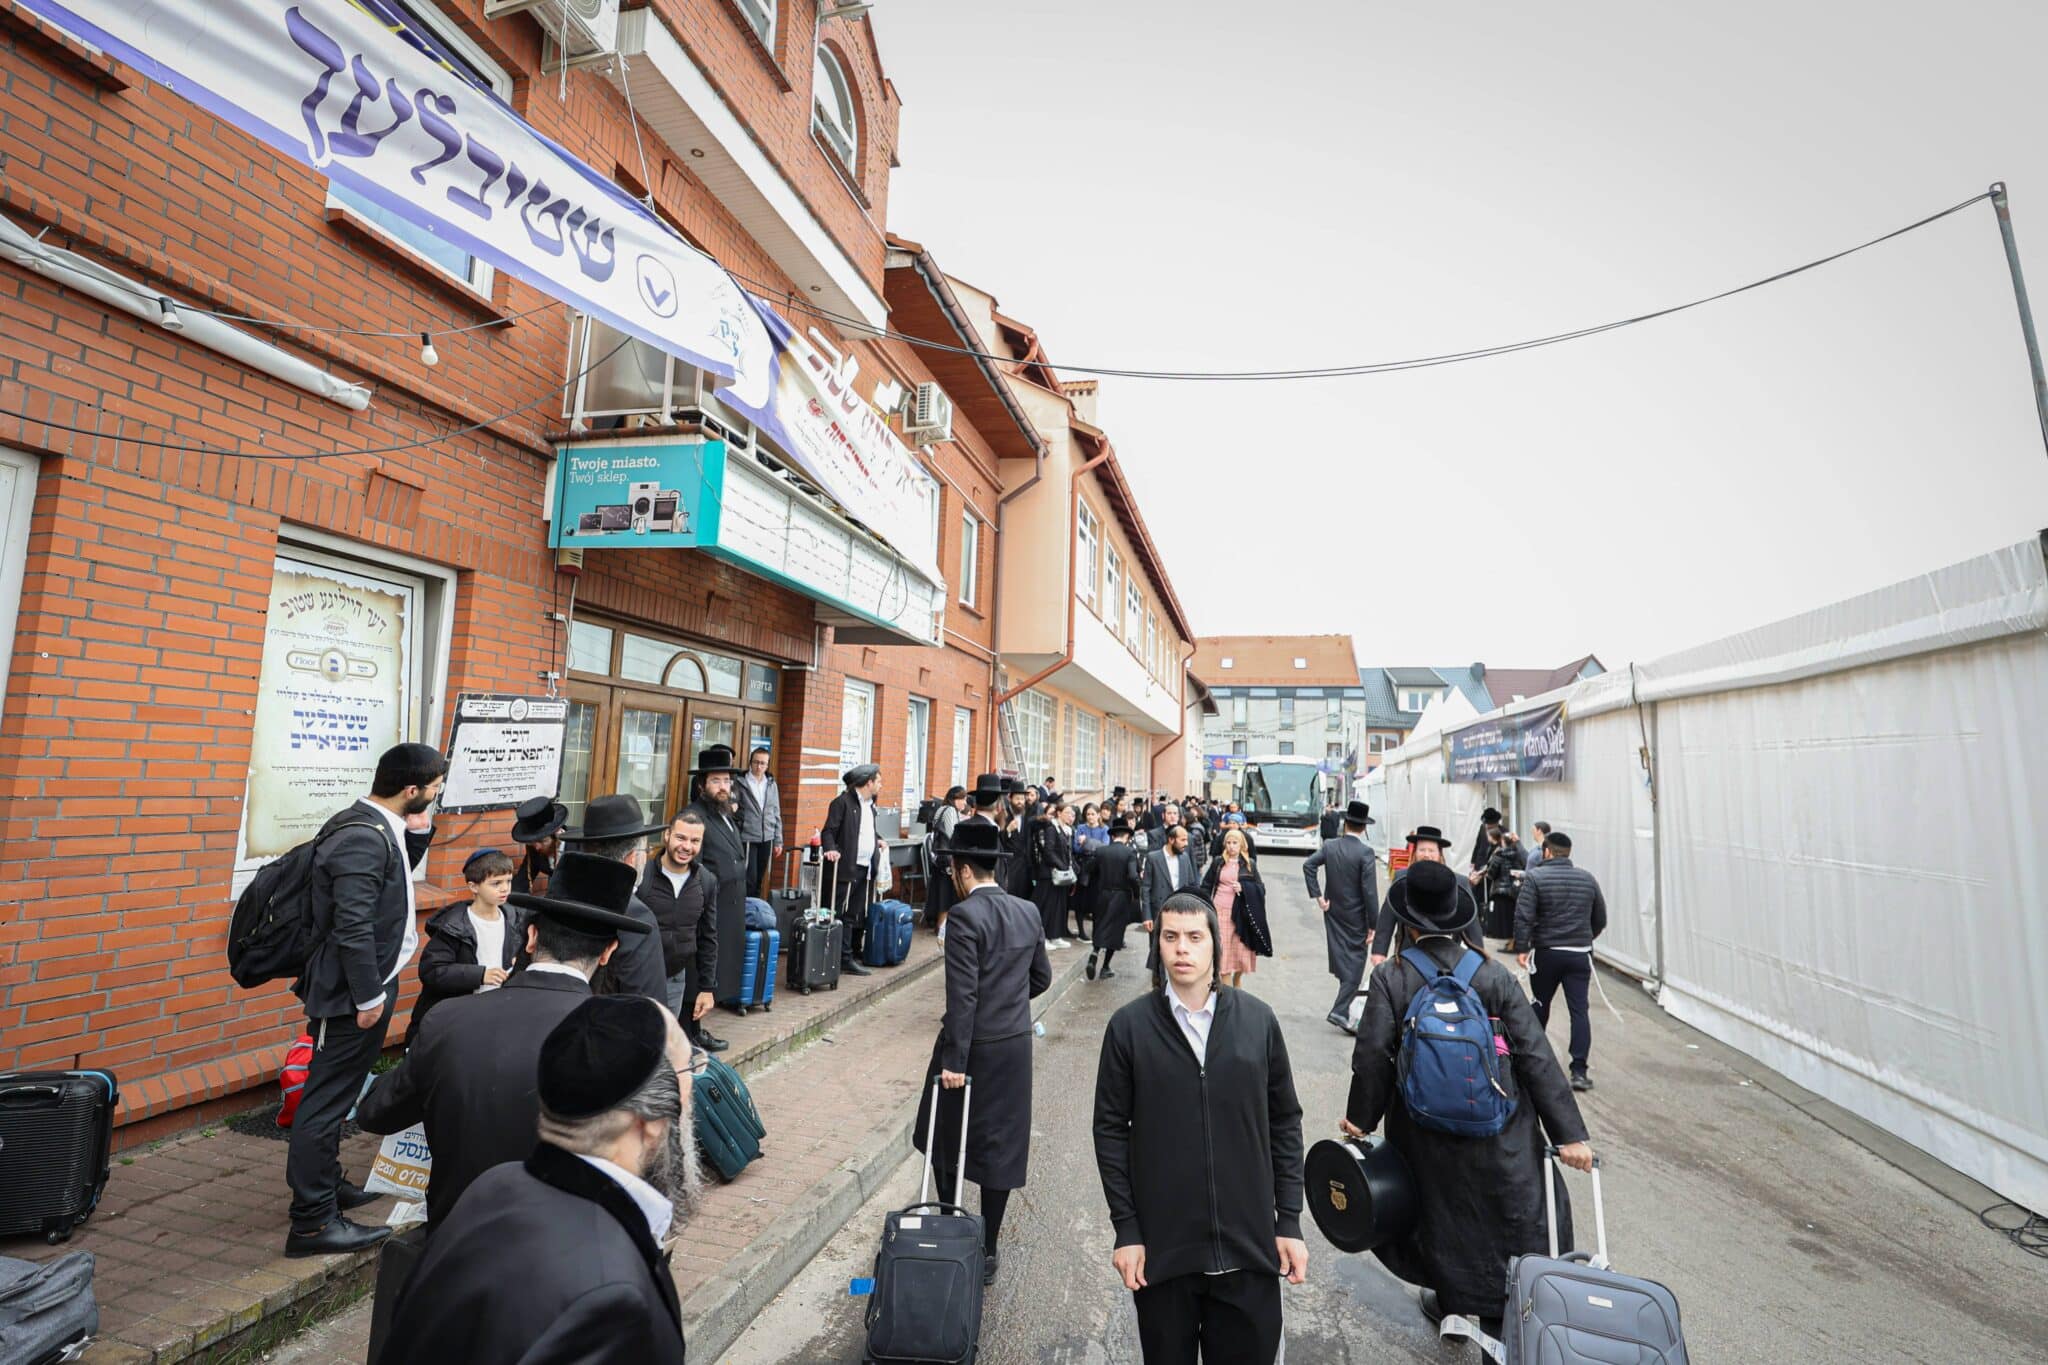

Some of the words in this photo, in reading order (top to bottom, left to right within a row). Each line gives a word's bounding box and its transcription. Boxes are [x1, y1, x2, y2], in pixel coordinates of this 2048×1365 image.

[285, 6, 615, 283] שטיבלעך
[571, 457, 608, 473] Twoje
[612, 455, 661, 469] miasto.
[570, 471, 594, 485] Twój
[597, 470, 630, 485] sklep.
[279, 592, 315, 620] שטוב
[319, 587, 364, 617] הייליגע
[367, 608, 388, 634] דער
[293, 708, 369, 731] שטיבלעך
[290, 732, 370, 752] המפוארים
